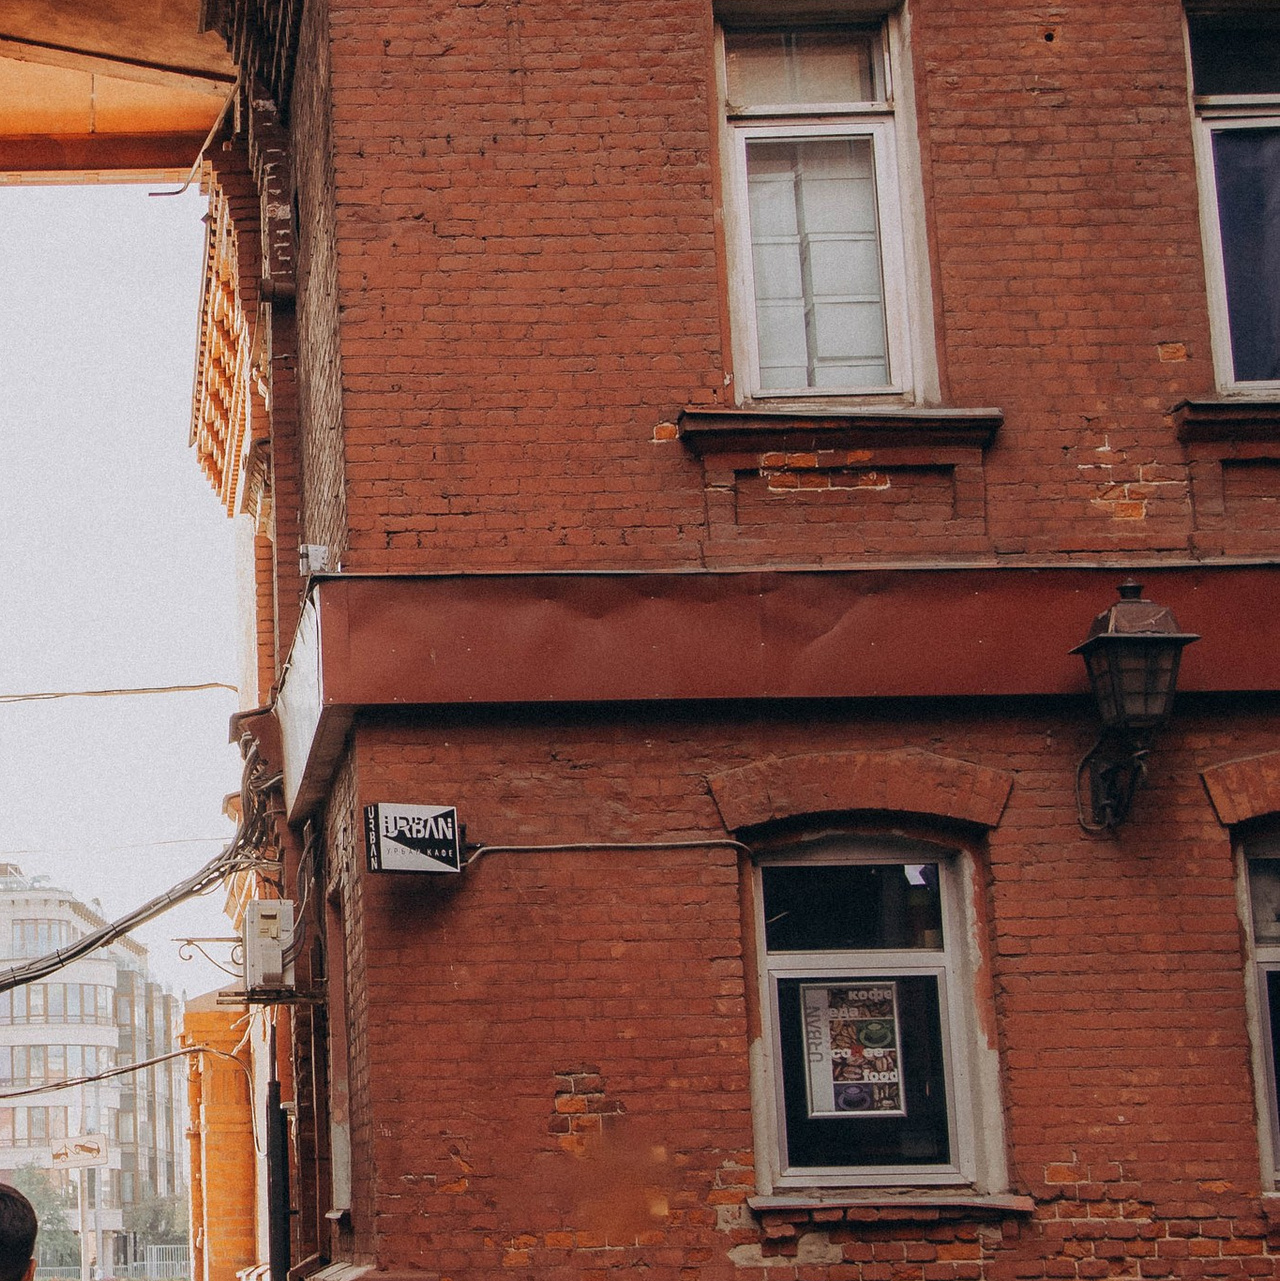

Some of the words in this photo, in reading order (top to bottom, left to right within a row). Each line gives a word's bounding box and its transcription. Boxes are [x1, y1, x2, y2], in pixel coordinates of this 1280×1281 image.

[383, 816, 453, 840] URBAN
[368, 806, 378, 870] URBAN
[848, 989, 891, 1001] кофе
[829, 1007, 859, 1019] еда
[806, 1006, 823, 1062] URBAN
[862, 1068, 898, 1082] food
